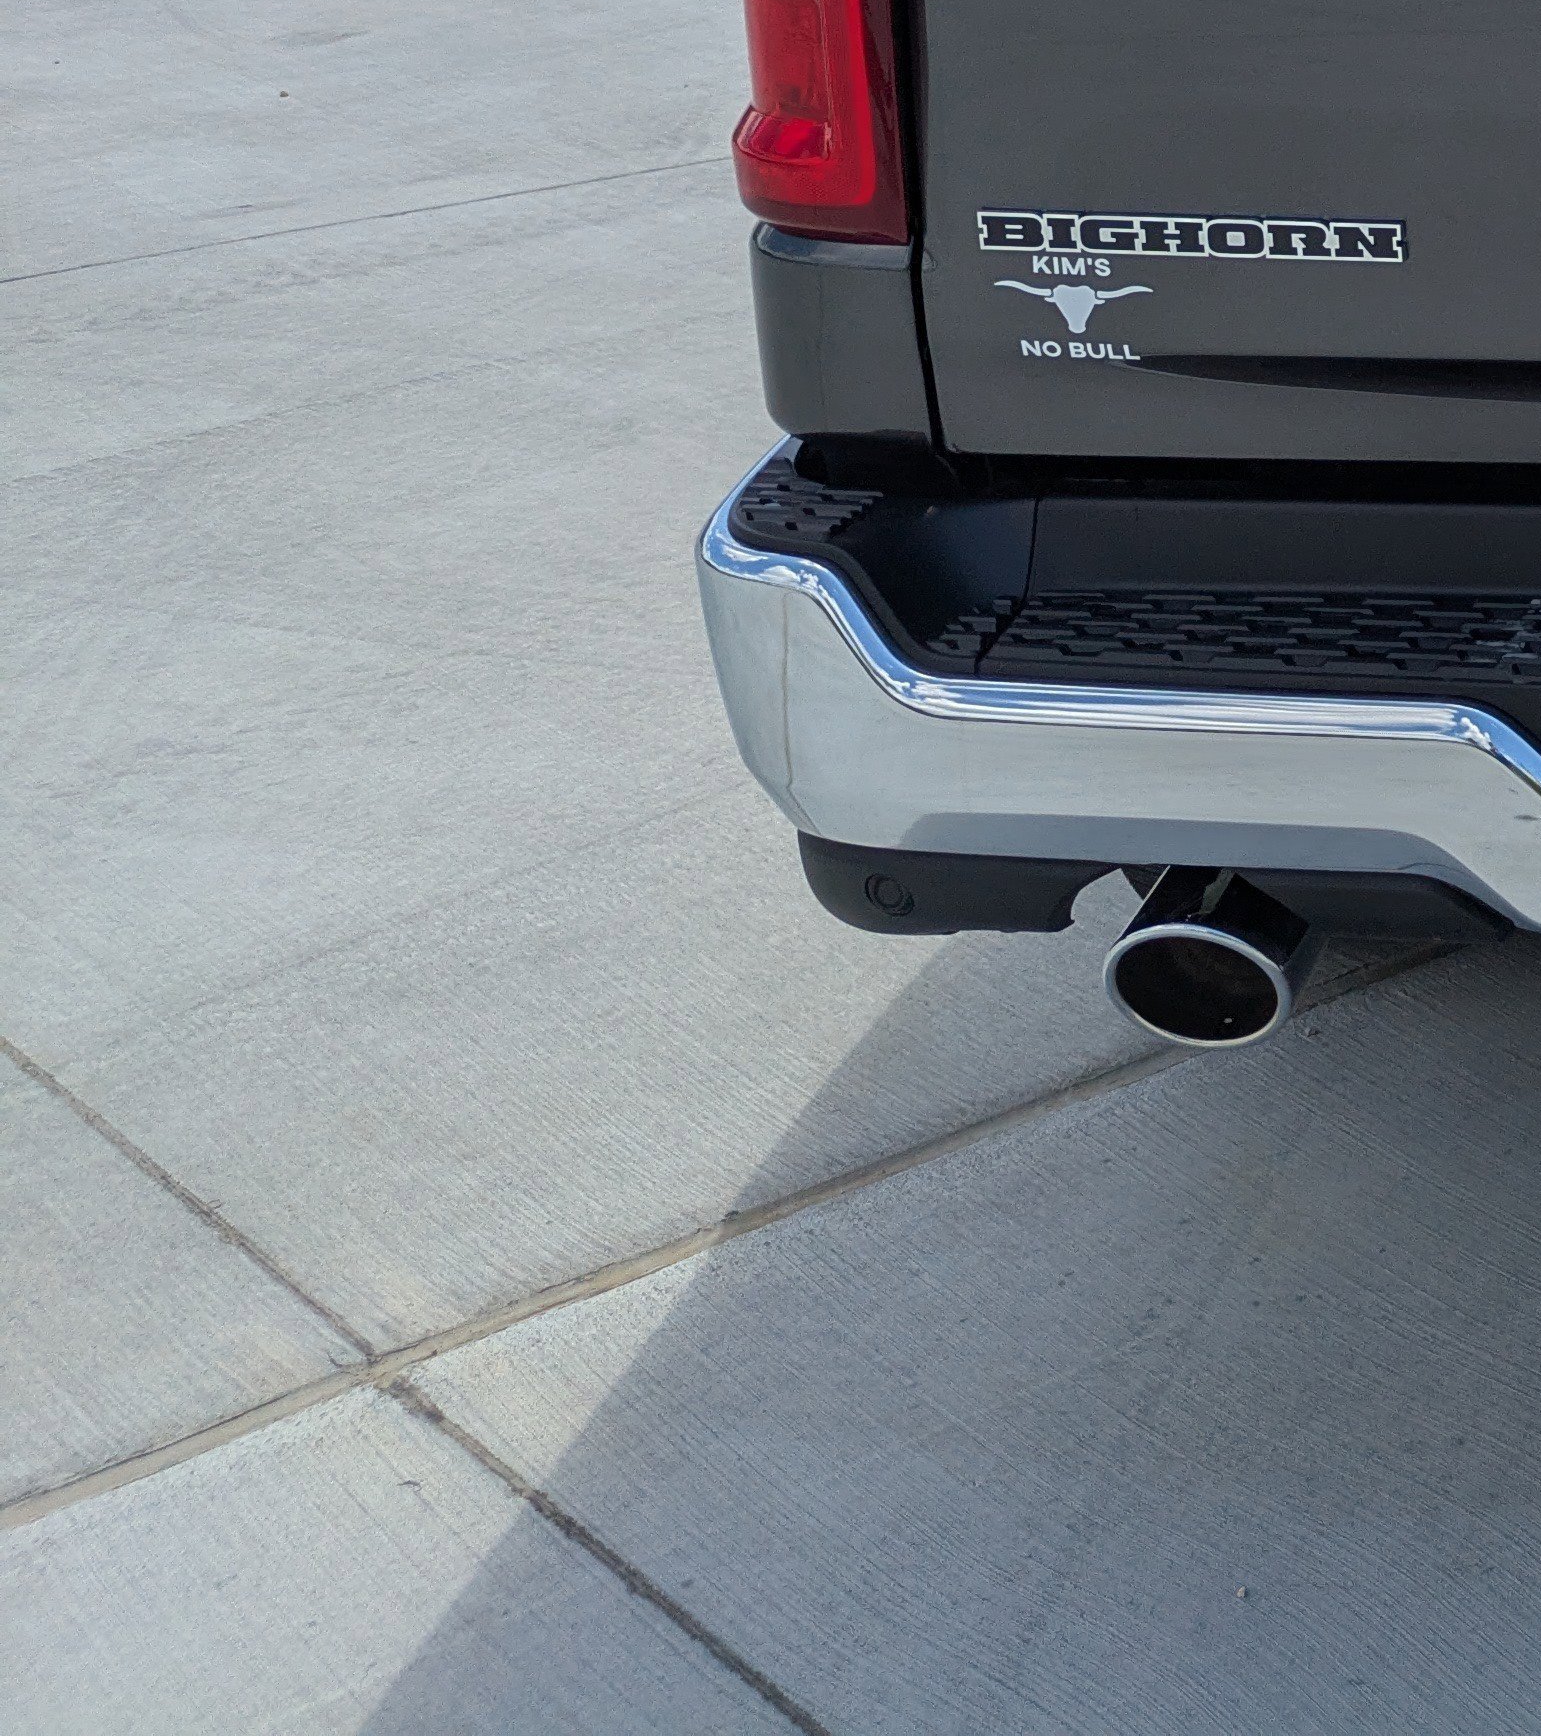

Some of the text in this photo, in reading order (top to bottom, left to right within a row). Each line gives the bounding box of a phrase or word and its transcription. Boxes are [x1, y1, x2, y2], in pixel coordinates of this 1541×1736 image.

[976, 209, 1405, 262] BIGHORN
[1032, 255, 1111, 277] KIM'S
[1020, 339, 1141, 361] NO BULL
